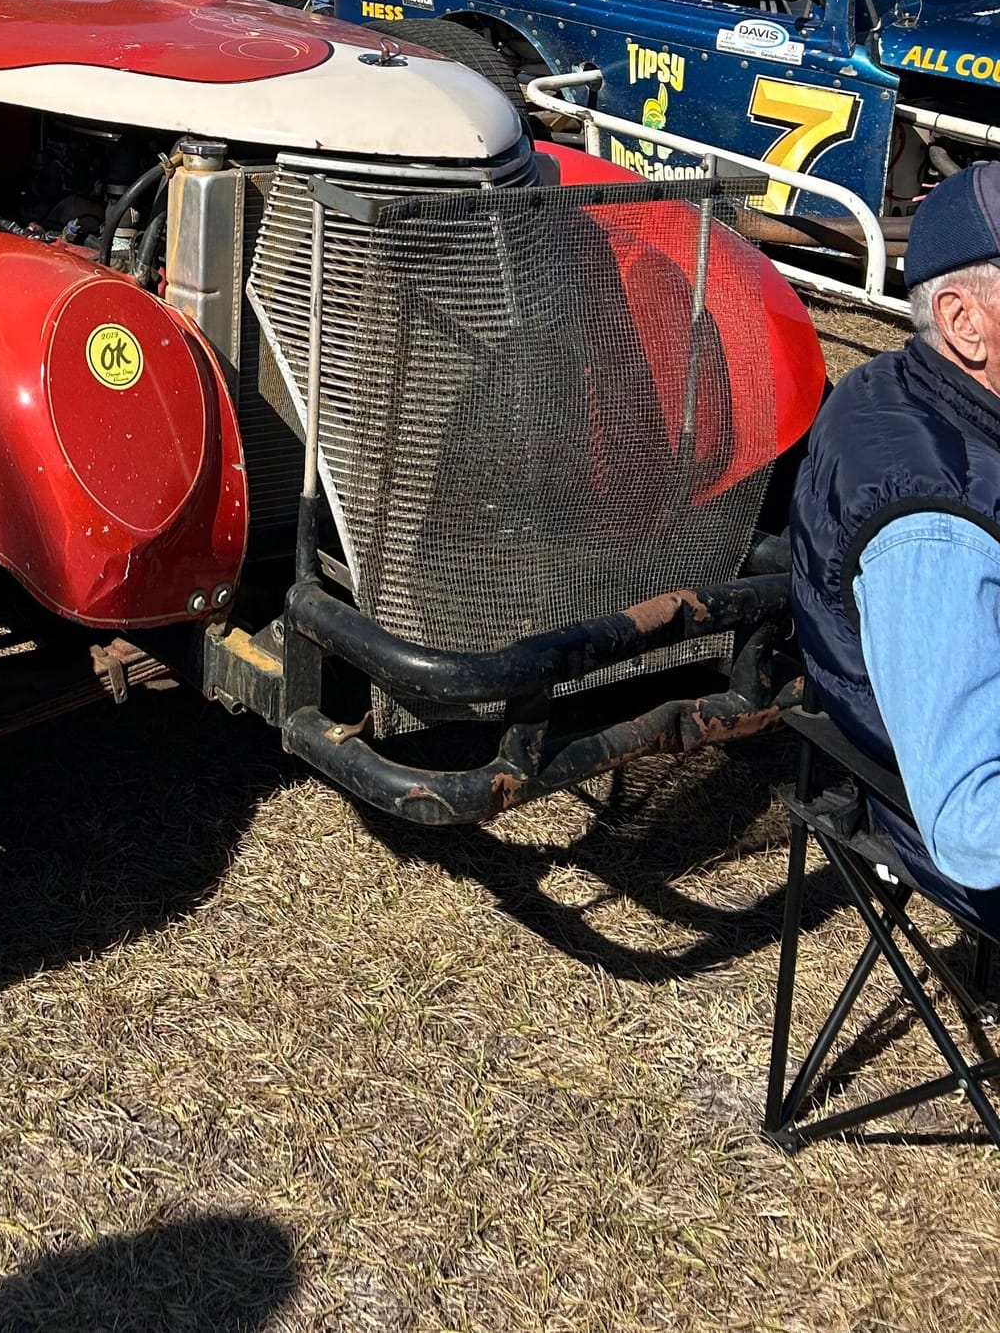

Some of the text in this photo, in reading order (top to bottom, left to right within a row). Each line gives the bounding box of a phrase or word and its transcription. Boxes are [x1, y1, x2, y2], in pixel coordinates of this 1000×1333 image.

[361, 1, 404, 21] HESS
[739, 25, 779, 41] DAVIS
[901, 45, 949, 72] ALL
[748, 75, 863, 216] 7
[100, 337, 132, 370] OK
